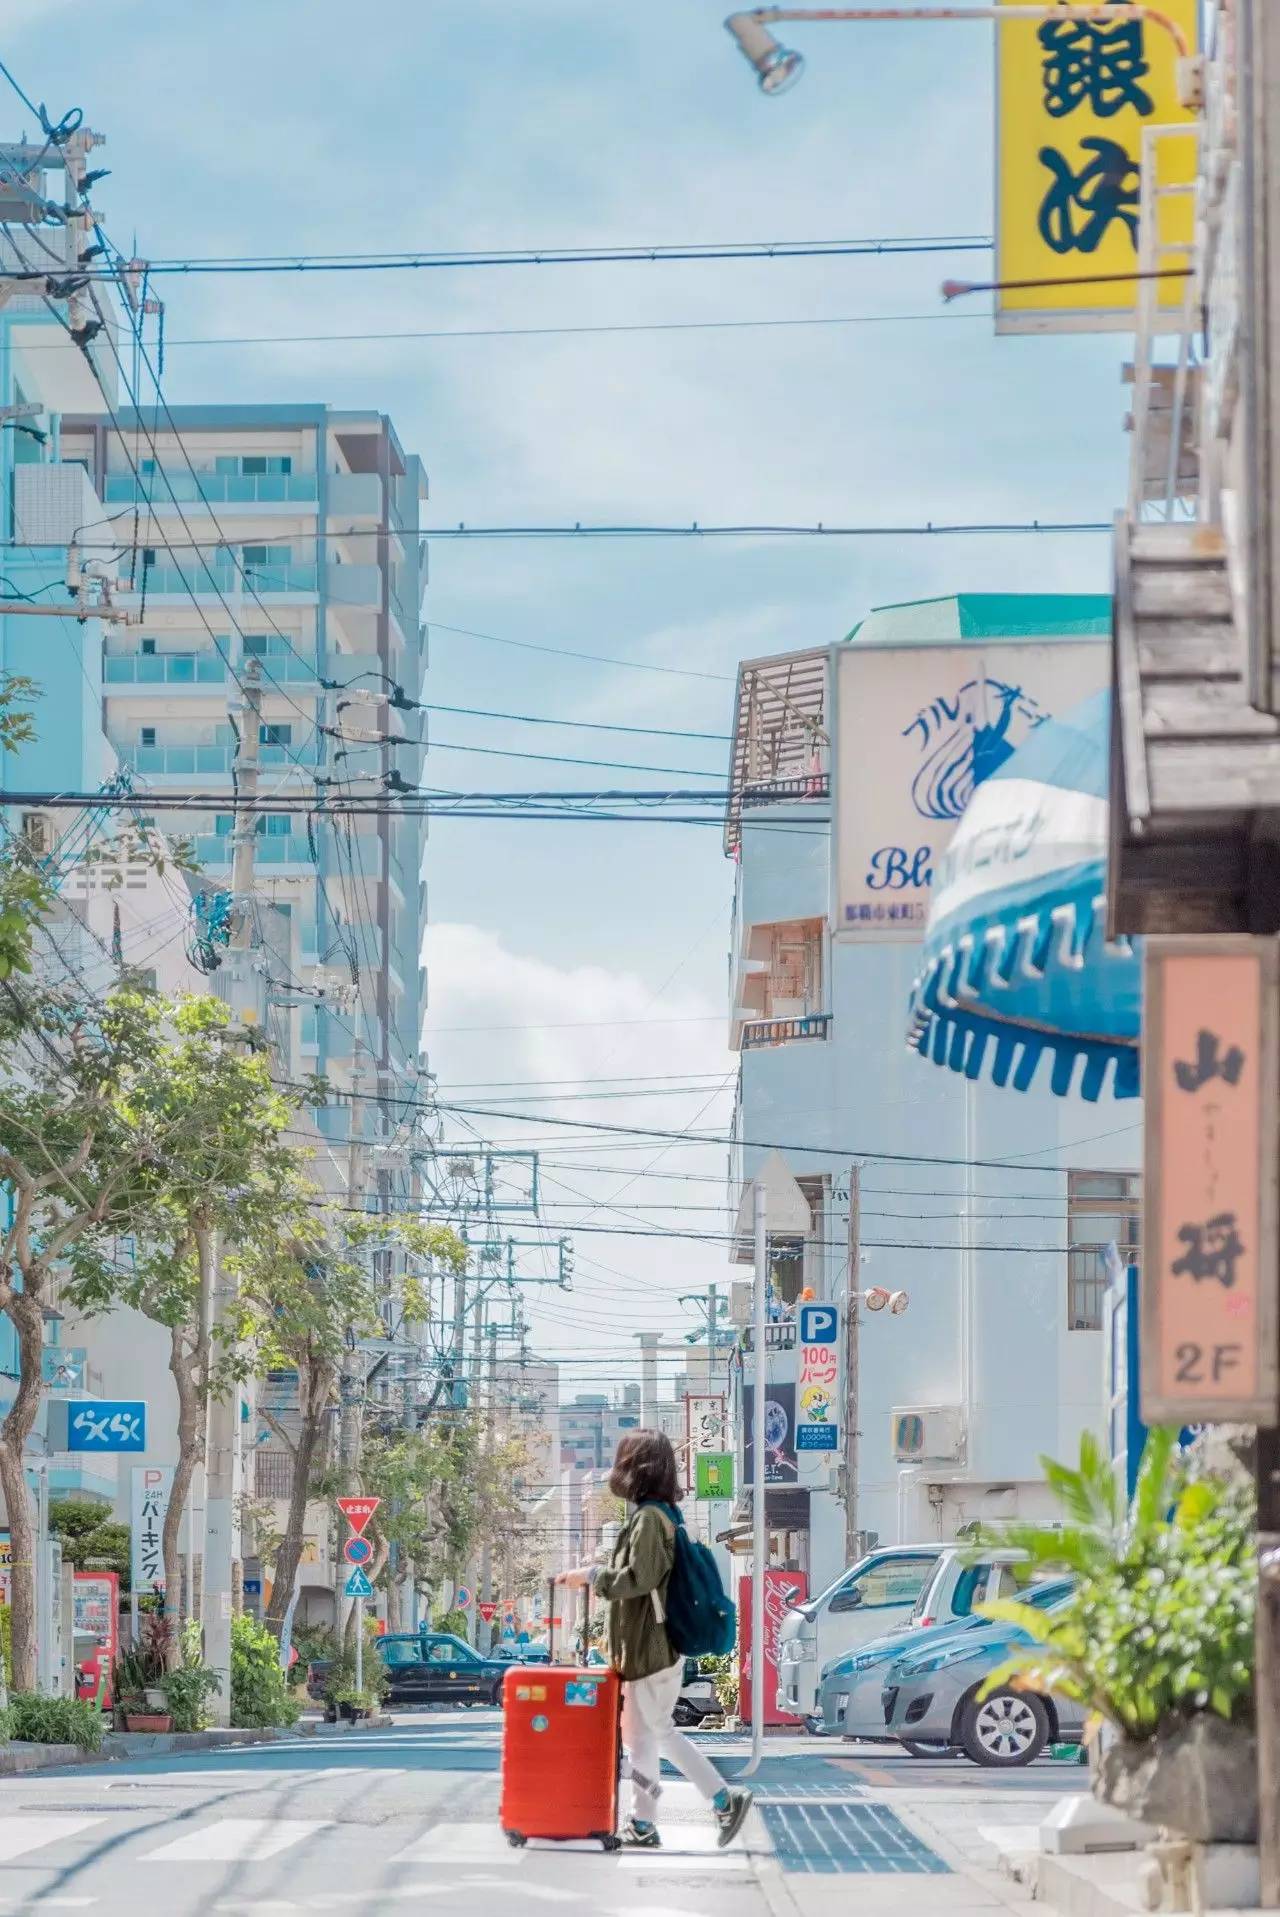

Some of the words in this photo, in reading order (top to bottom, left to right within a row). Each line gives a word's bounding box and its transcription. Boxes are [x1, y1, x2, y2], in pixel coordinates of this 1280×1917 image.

[800, 1367, 837, 1384] パーク
[1174, 1342, 1242, 1384] 2F
[141, 1501, 159, 1579] パーキング
